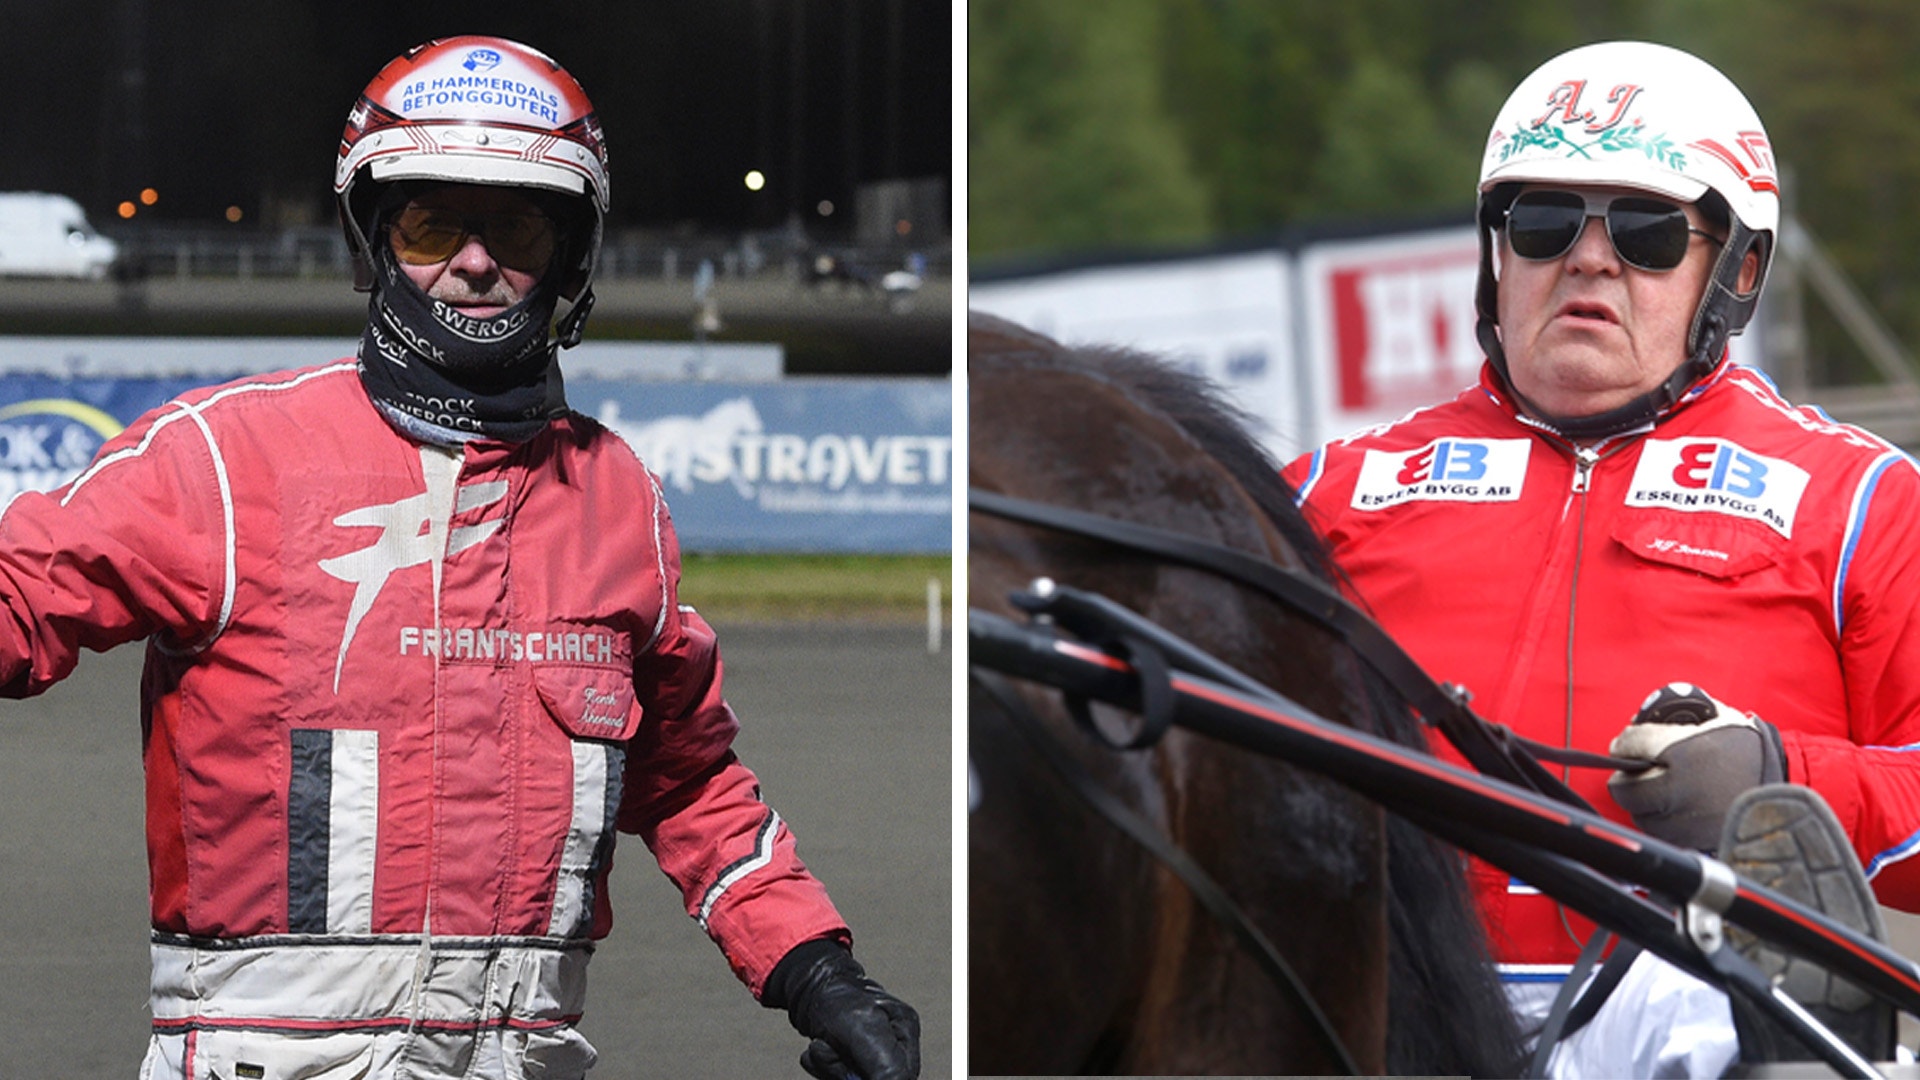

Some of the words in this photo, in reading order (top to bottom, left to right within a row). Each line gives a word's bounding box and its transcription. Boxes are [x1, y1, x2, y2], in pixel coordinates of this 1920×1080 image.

[402, 90, 559, 124] BETONGGJUTERI
[403, 79, 426, 98] AB
[431, 76, 559, 109] HAMMERDALS
[431, 300, 529, 337] SWEROCK
[1361, 486, 1420, 505] ESSEN
[1425, 484, 1479, 496] BYGG
[1485, 485, 1512, 497] AB
[1634, 490, 1699, 506] ESSEN
[1703, 494, 1757, 514] BYGG
[1763, 508, 1786, 529] AB
[400, 626, 612, 664] FRANTSCHACH
